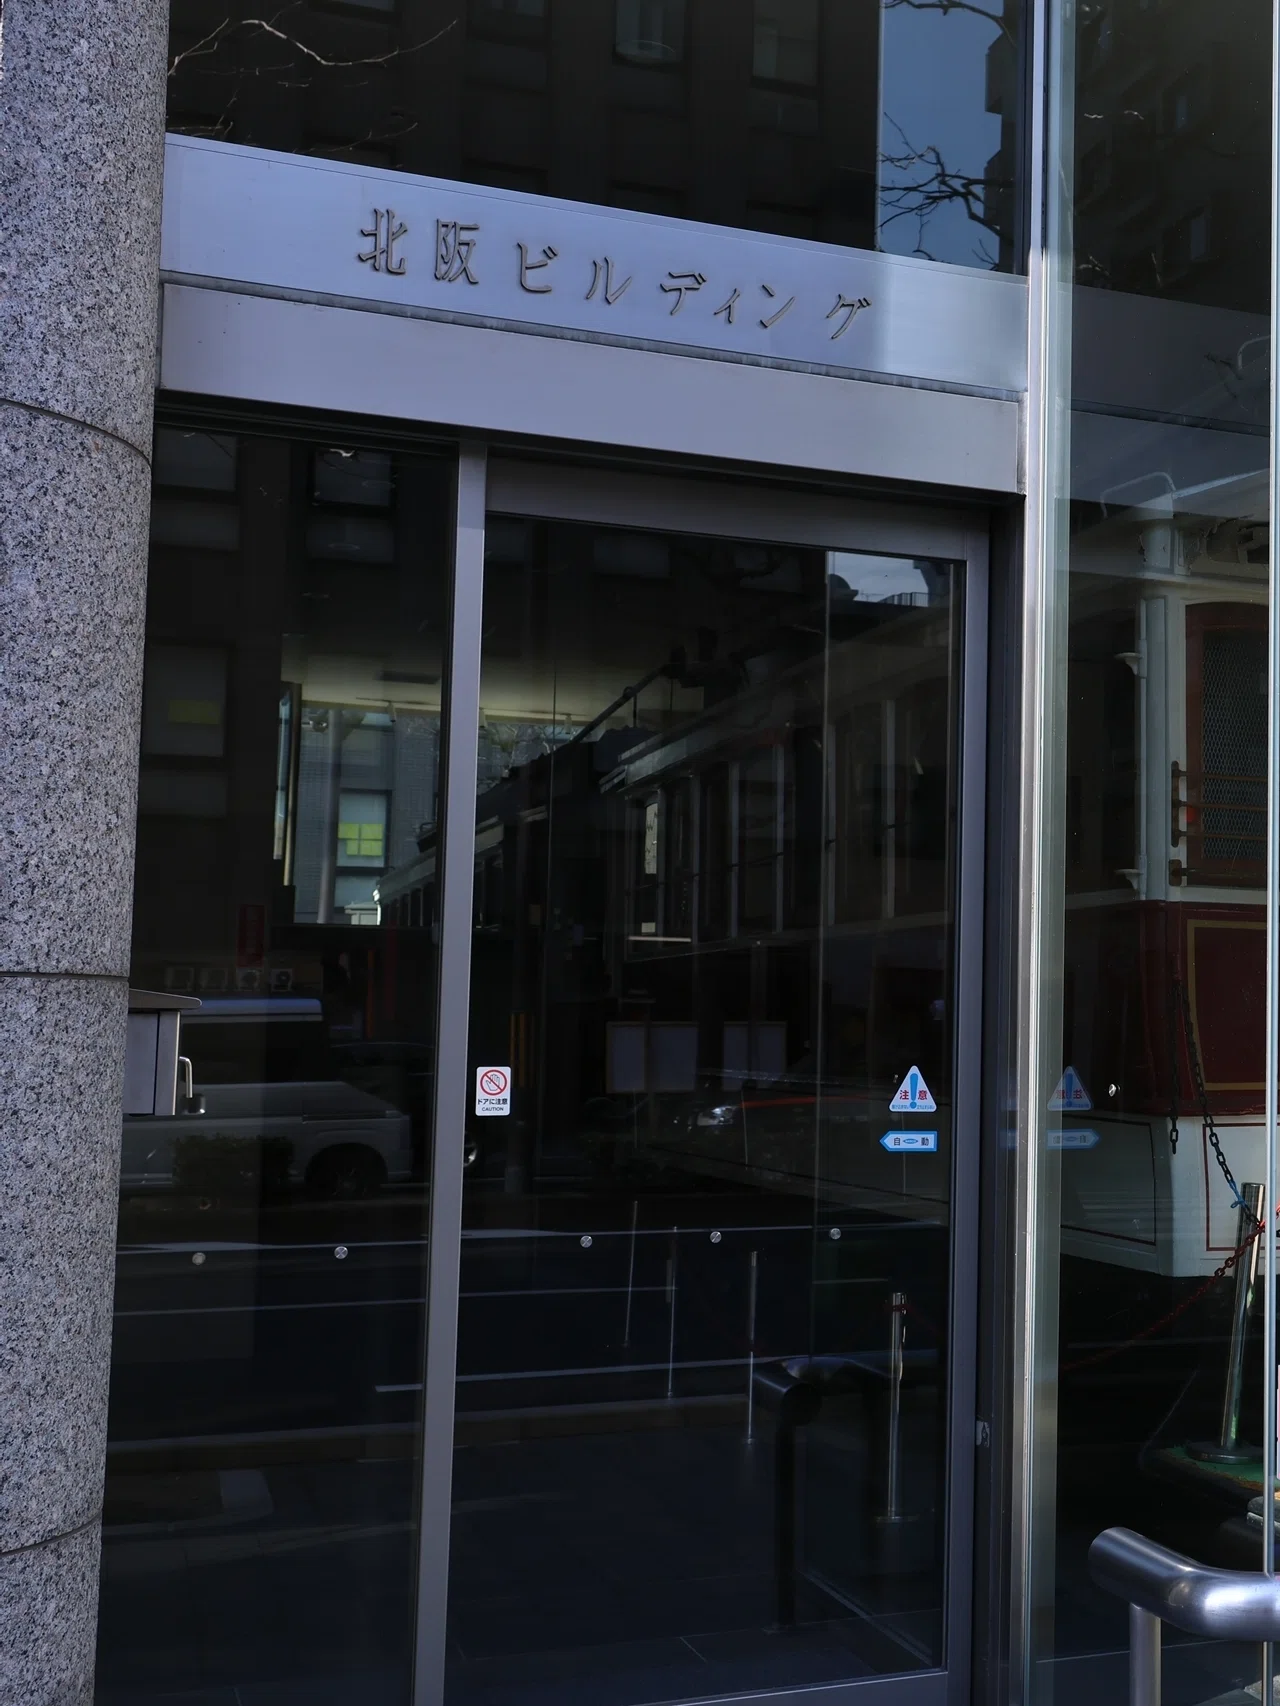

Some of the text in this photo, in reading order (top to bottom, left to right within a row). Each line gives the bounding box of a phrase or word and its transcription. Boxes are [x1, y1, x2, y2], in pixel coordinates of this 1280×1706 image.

[357, 207, 873, 341] 北阪ビルディング
[899, 1089, 928, 1101] 注意
